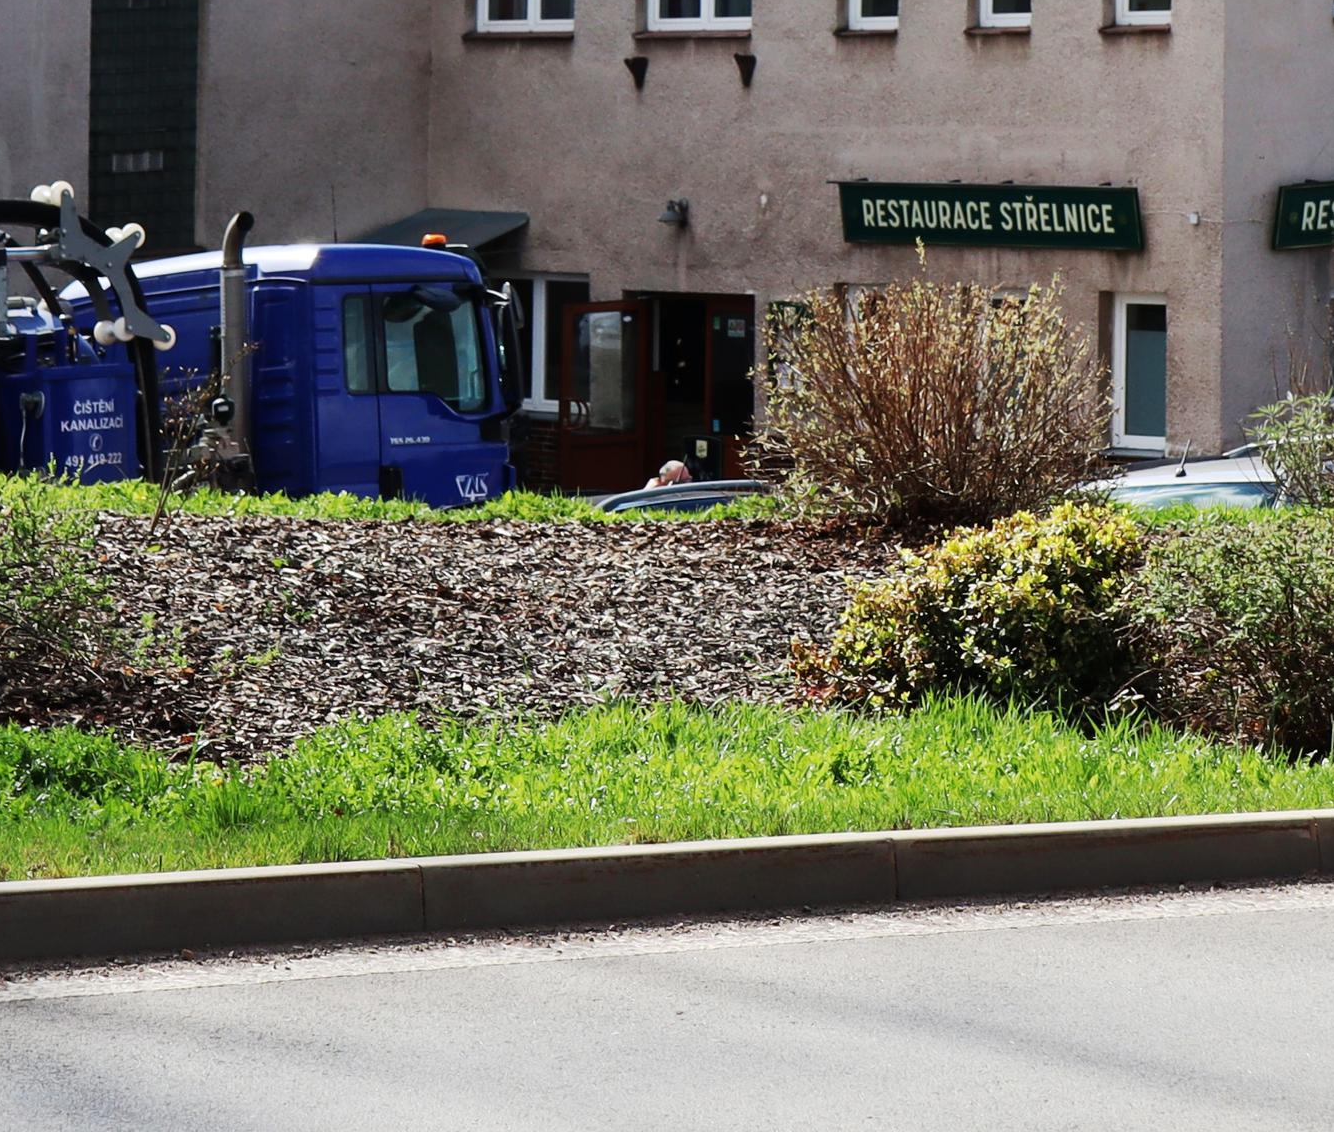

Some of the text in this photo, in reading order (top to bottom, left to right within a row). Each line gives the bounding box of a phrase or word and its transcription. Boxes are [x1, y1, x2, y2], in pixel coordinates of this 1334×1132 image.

[862, 195, 1115, 233] RESTAURACE STŘELNICE
[73, 398, 115, 415] ČIŠTĚNÍ
